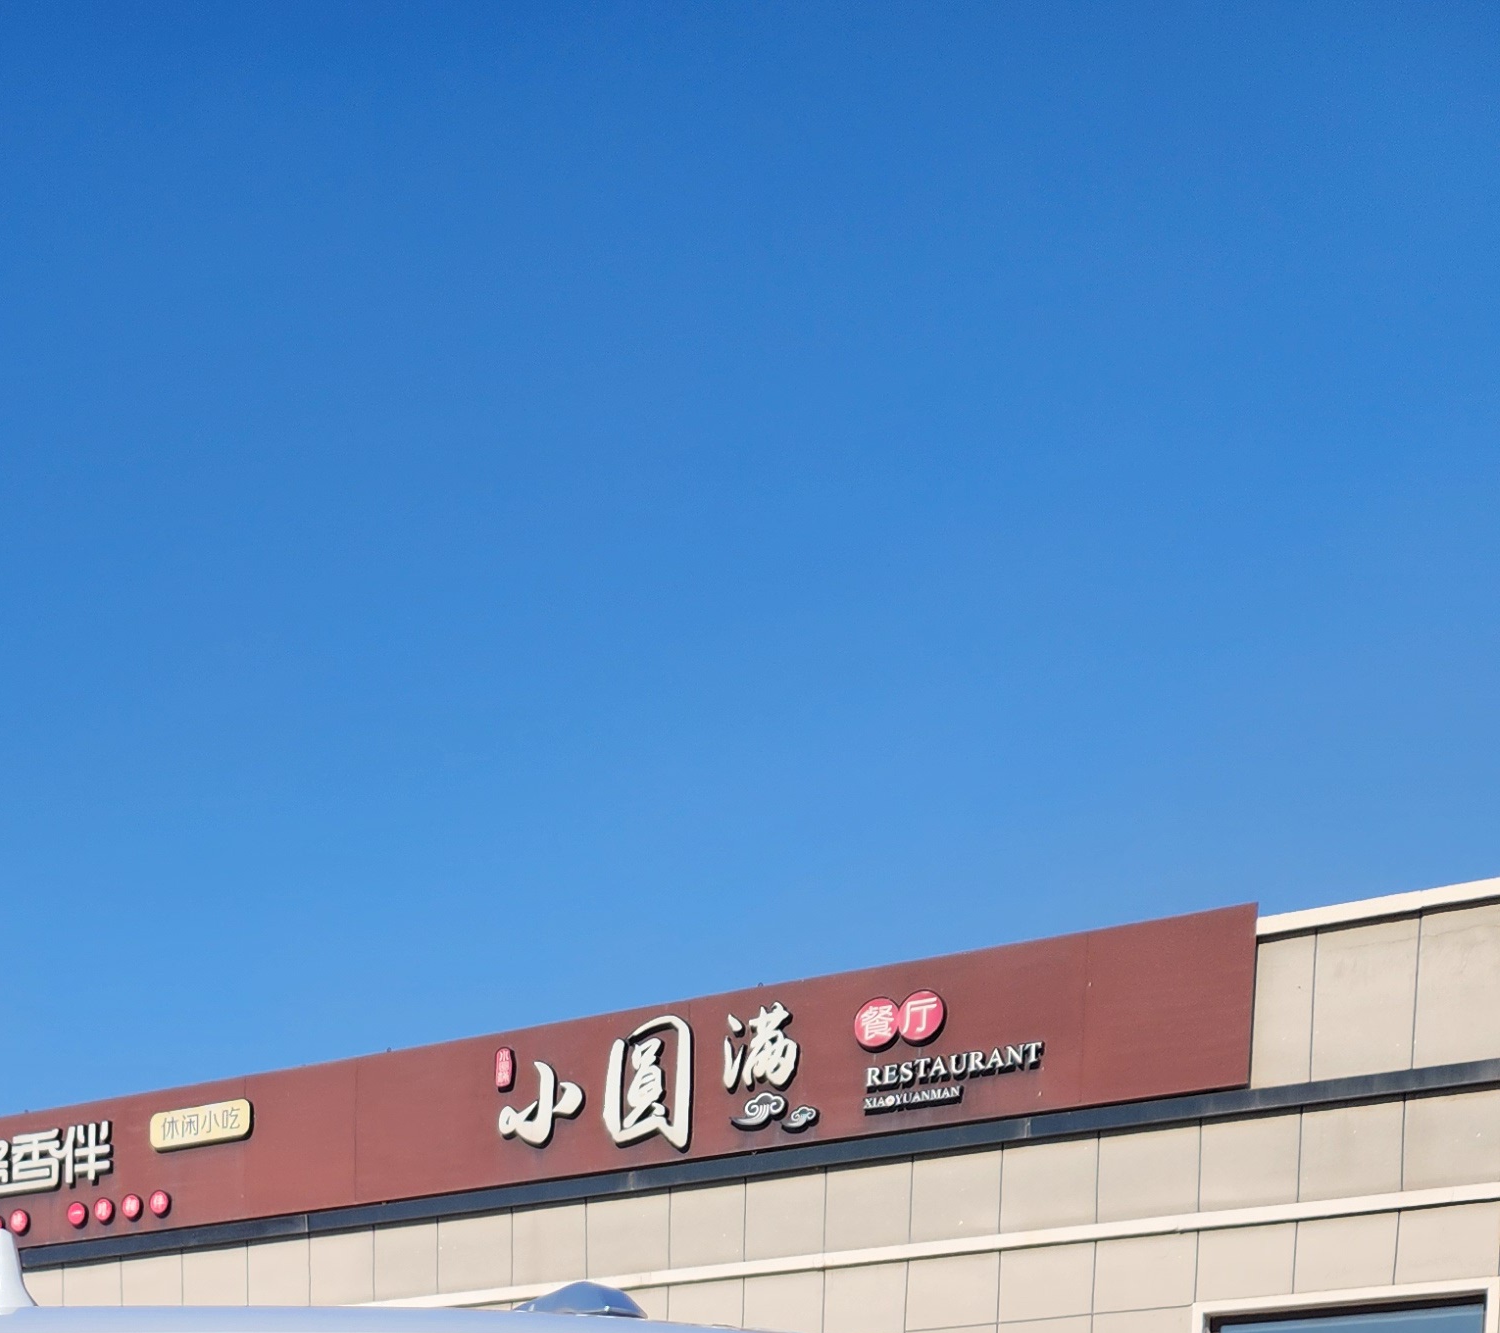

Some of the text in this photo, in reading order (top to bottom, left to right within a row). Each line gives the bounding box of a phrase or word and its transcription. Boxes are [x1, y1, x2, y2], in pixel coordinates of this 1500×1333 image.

[860, 997, 938, 1041] 餐厅
[866, 1041, 1043, 1087] RESTAURANT
[161, 1107, 241, 1141] 休闲小吃
